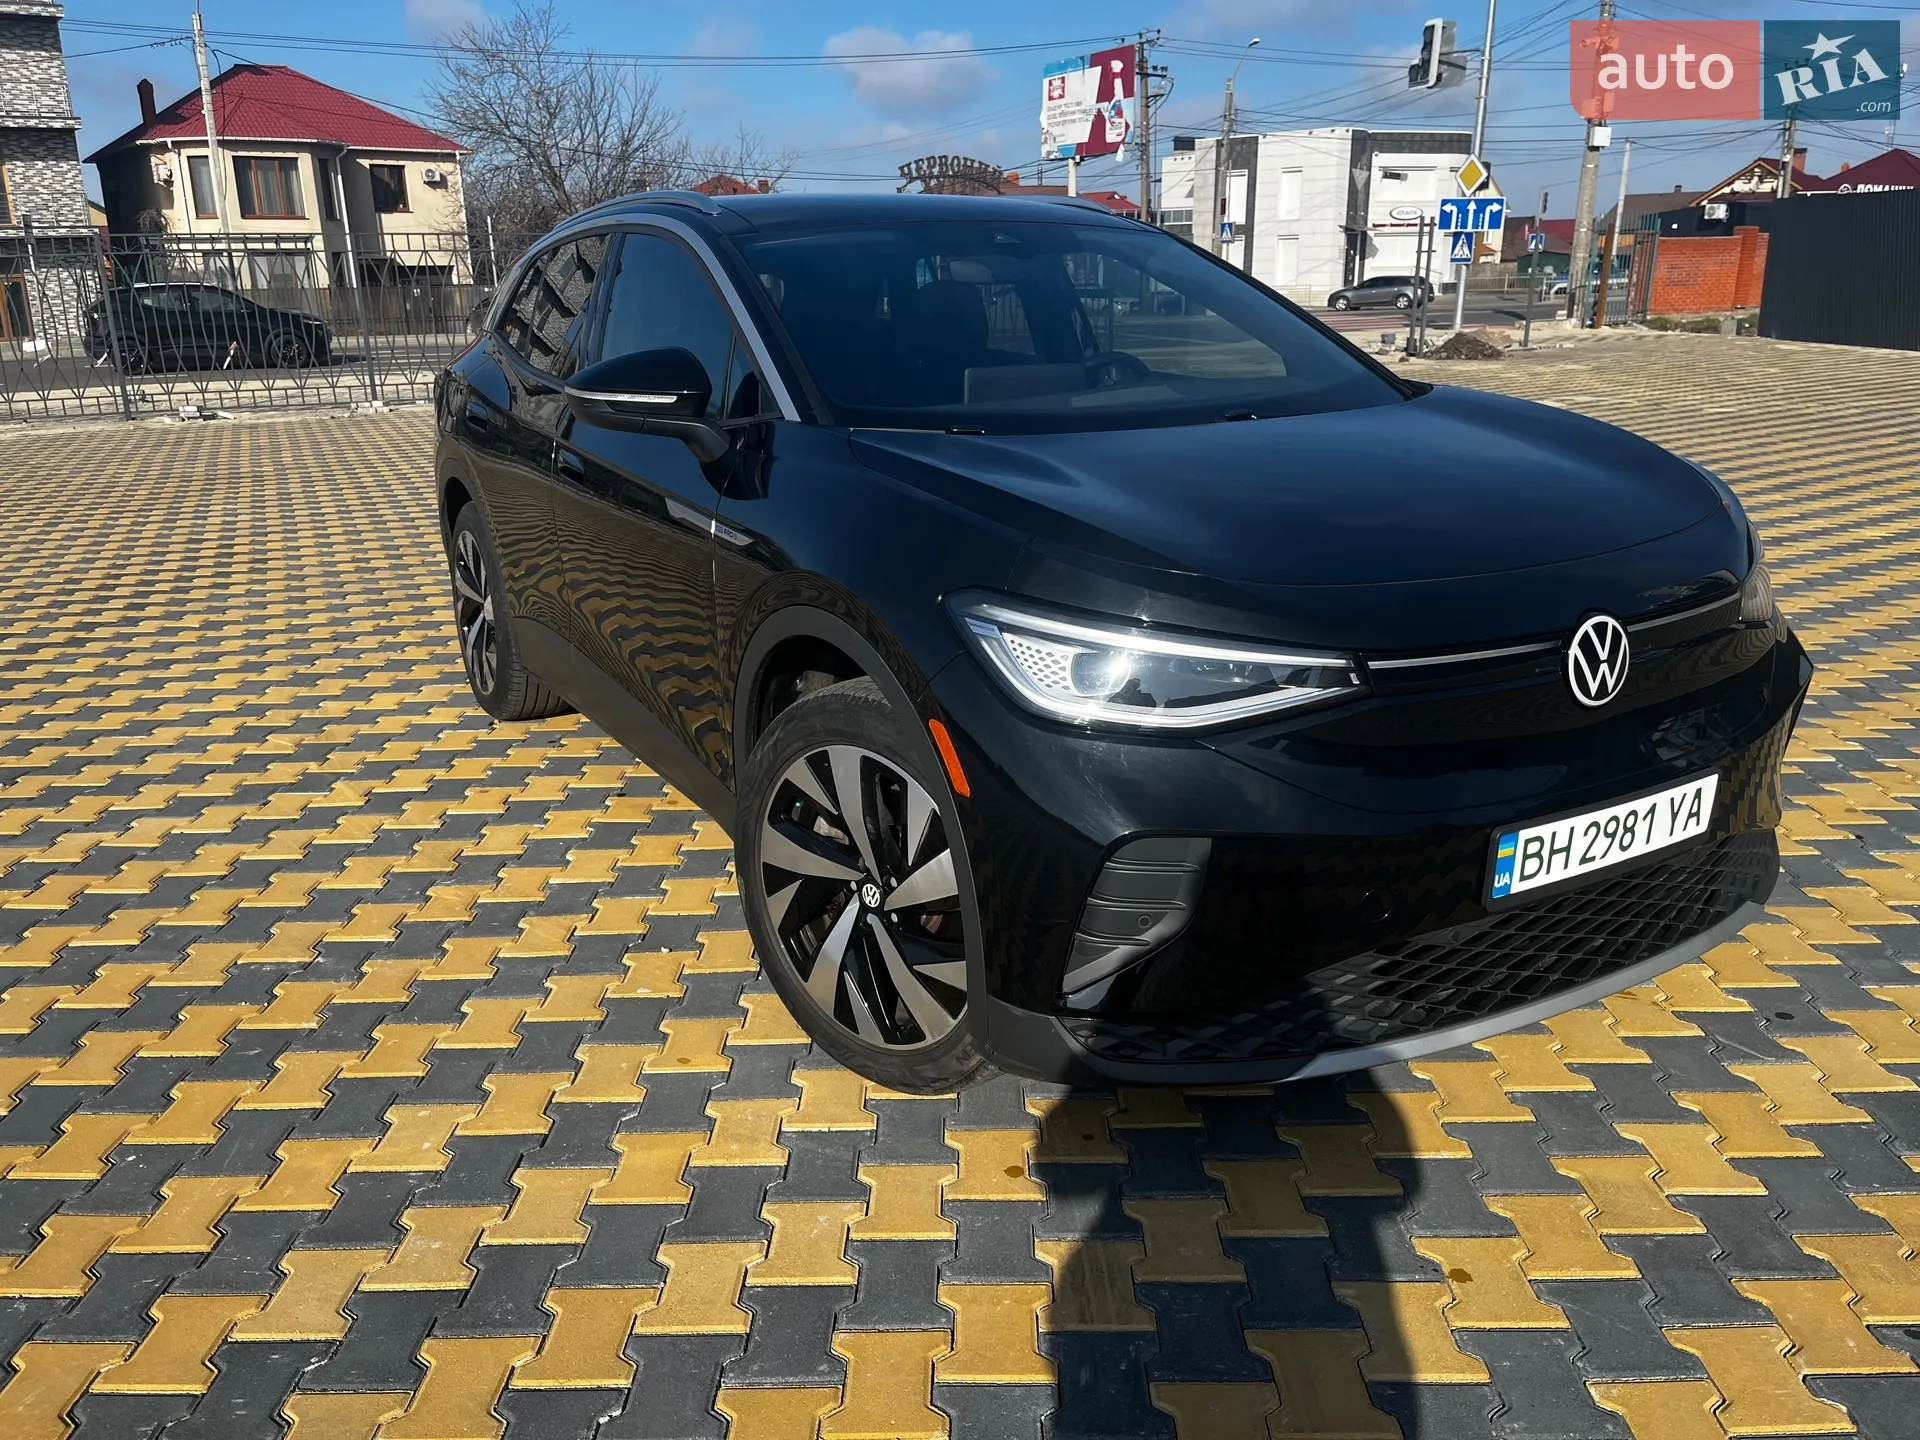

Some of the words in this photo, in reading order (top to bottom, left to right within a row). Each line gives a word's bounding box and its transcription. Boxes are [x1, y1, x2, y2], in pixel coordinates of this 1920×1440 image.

[1518, 826, 1575, 883] BH
[1578, 802, 1657, 866] 2981
[1669, 787, 1703, 837] YA
[1494, 872, 1511, 888] UA
